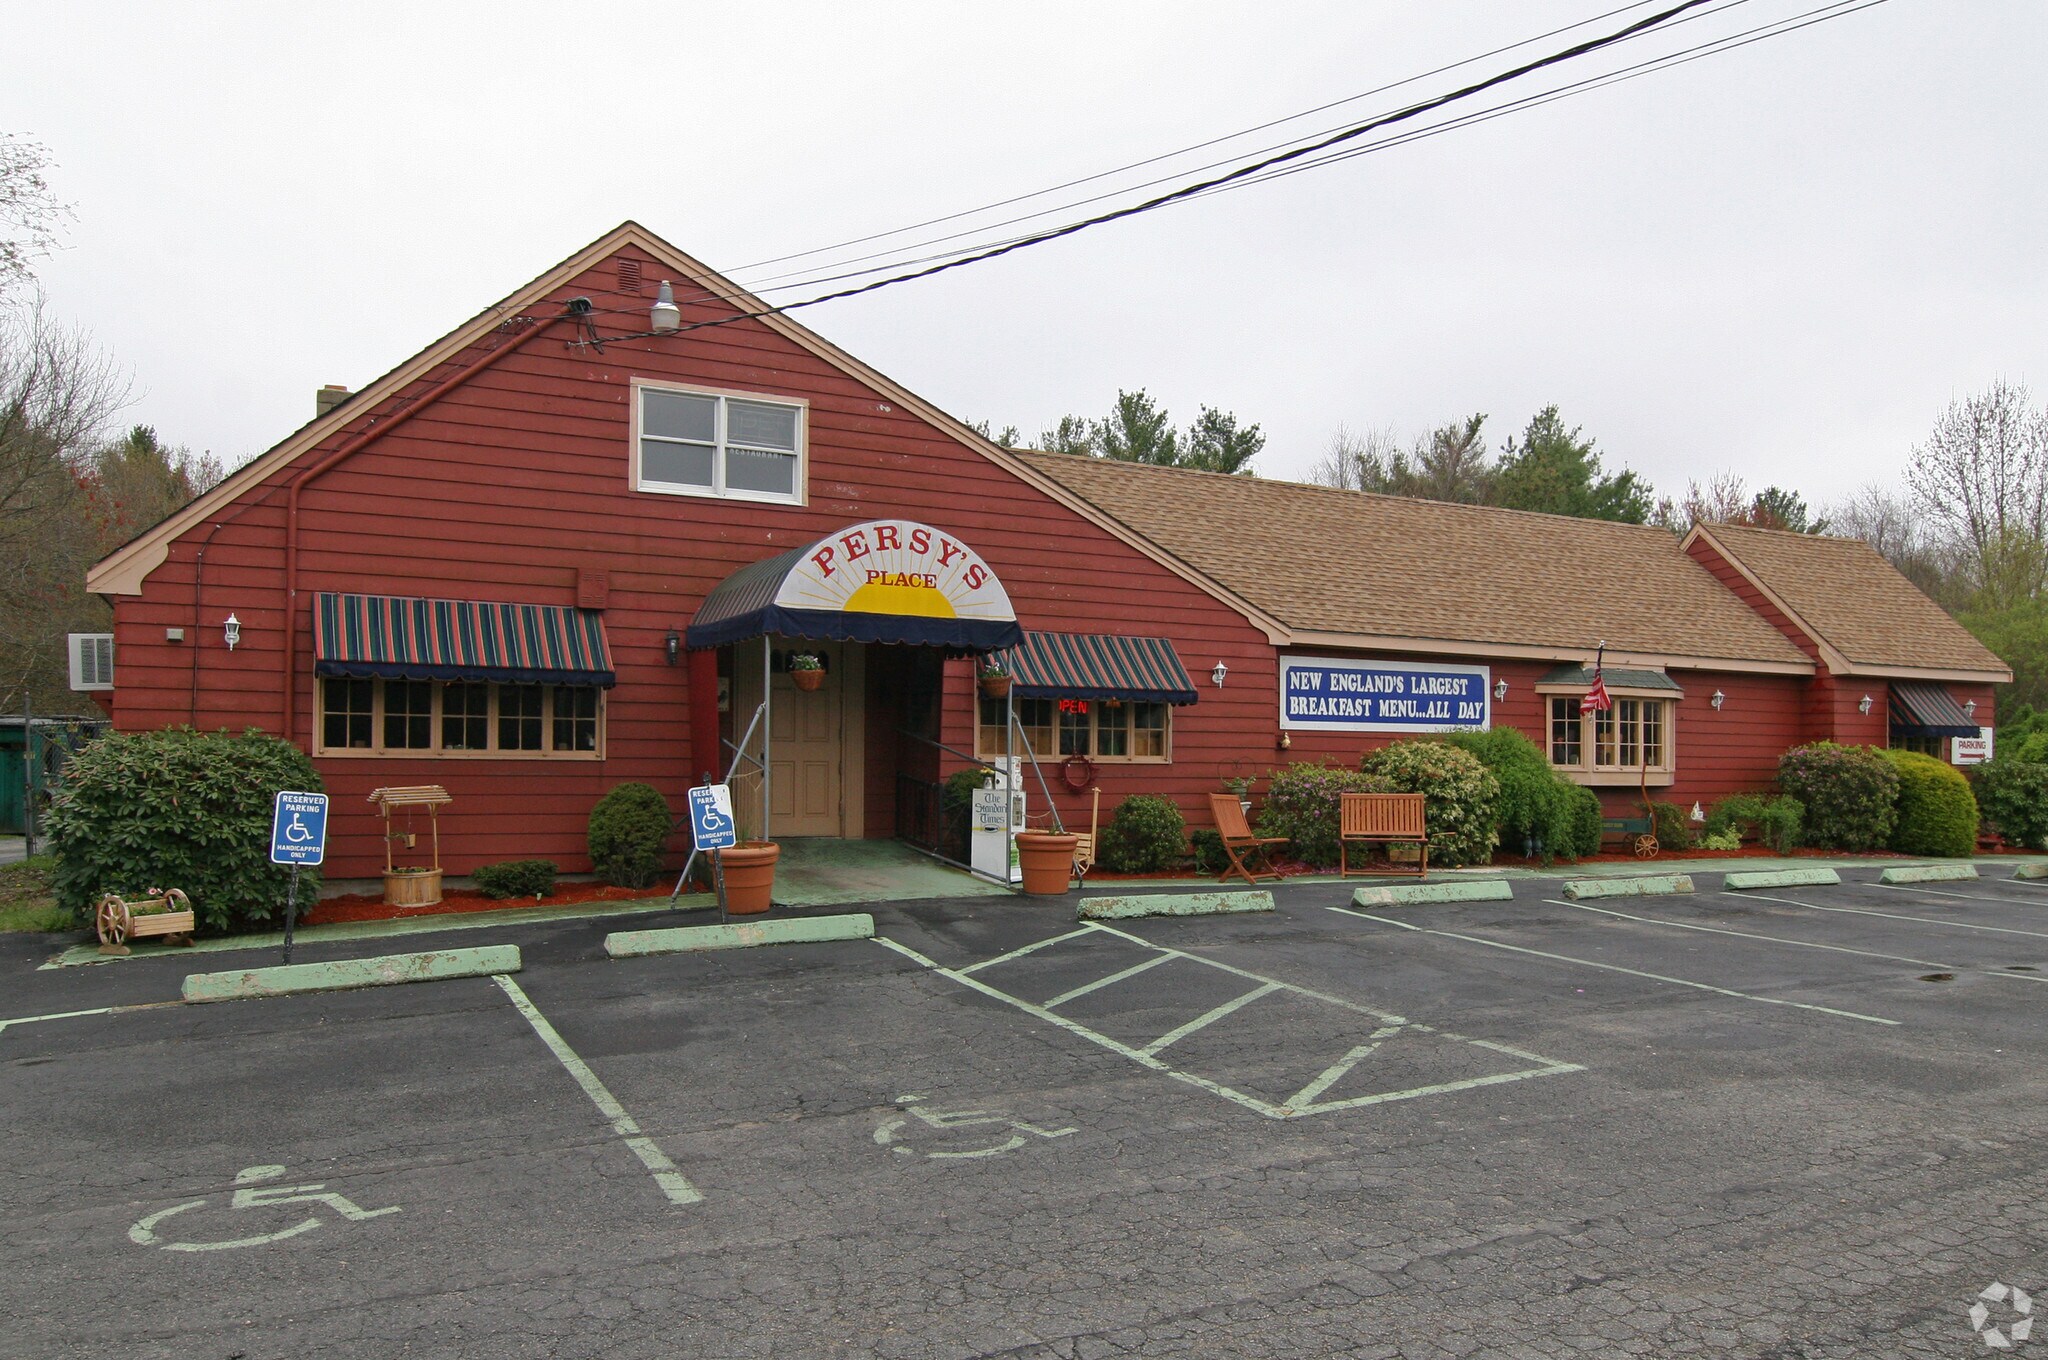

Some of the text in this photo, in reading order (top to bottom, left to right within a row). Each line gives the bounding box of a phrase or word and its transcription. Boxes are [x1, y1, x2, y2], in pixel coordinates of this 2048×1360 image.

[811, 525, 988, 590] PERSY'S
[866, 569, 937, 589] PLACE
[1290, 672, 1468, 695] NEW ENGLAND'S LARGEST
[1290, 696, 1371, 717] BREAKFAST
[1458, 702, 1483, 719] DAY
[1958, 740, 1986, 749] PARKING
[283, 796, 324, 804] RESERVED
[984, 793, 1001, 803] The
[286, 804, 320, 812] PARKING
[980, 813, 1005, 824] Times
[698, 831, 732, 839] HANDICAPPED
